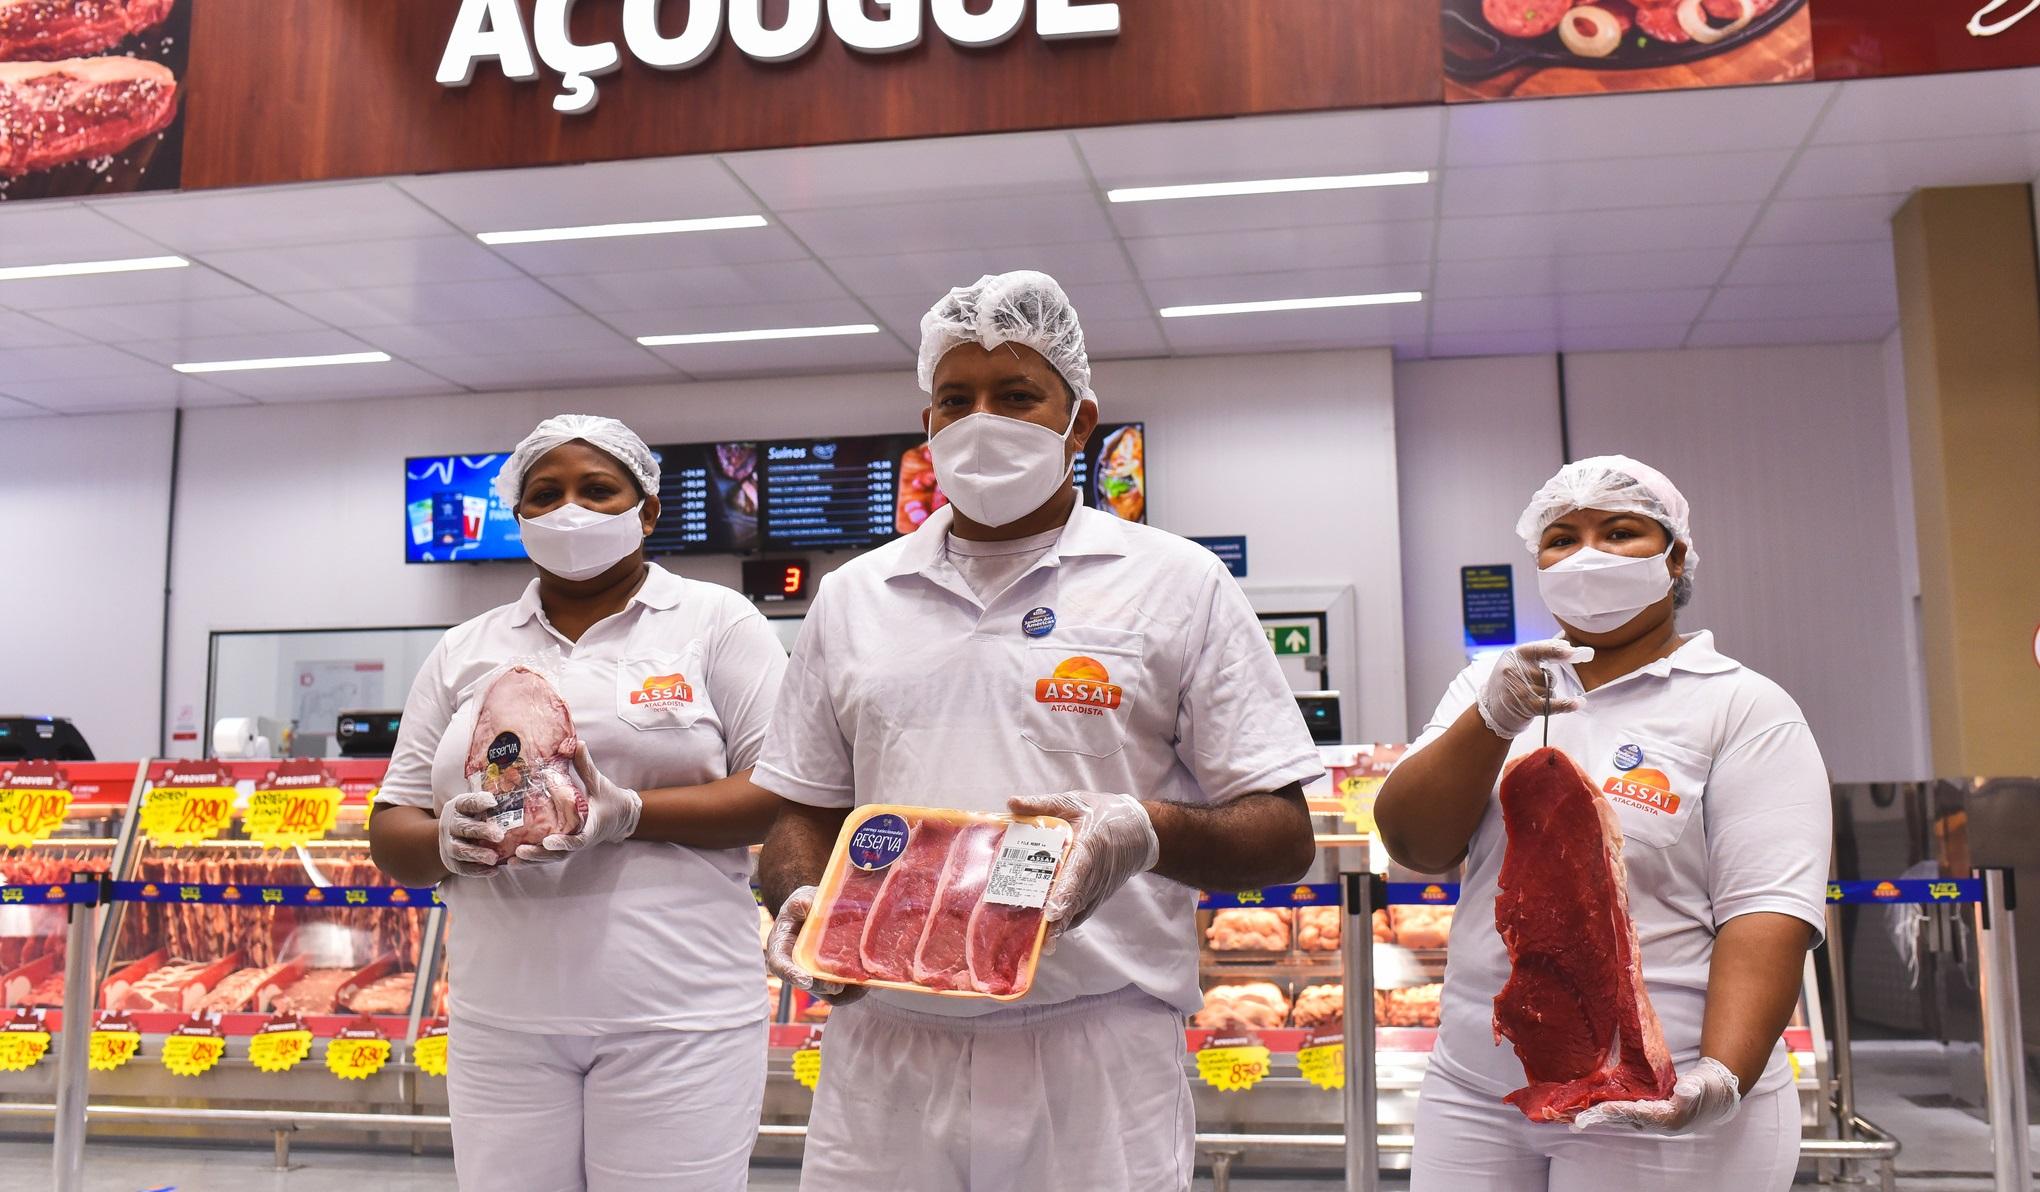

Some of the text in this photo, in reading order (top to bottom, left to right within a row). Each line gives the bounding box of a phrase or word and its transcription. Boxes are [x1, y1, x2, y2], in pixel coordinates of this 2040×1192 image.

[436, 0, 1119, 112] AÇOU
[784, 568, 800, 592] 3
[1050, 704, 1104, 717] ATACADISTA
[1611, 796, 1659, 816] ATACADISTA
